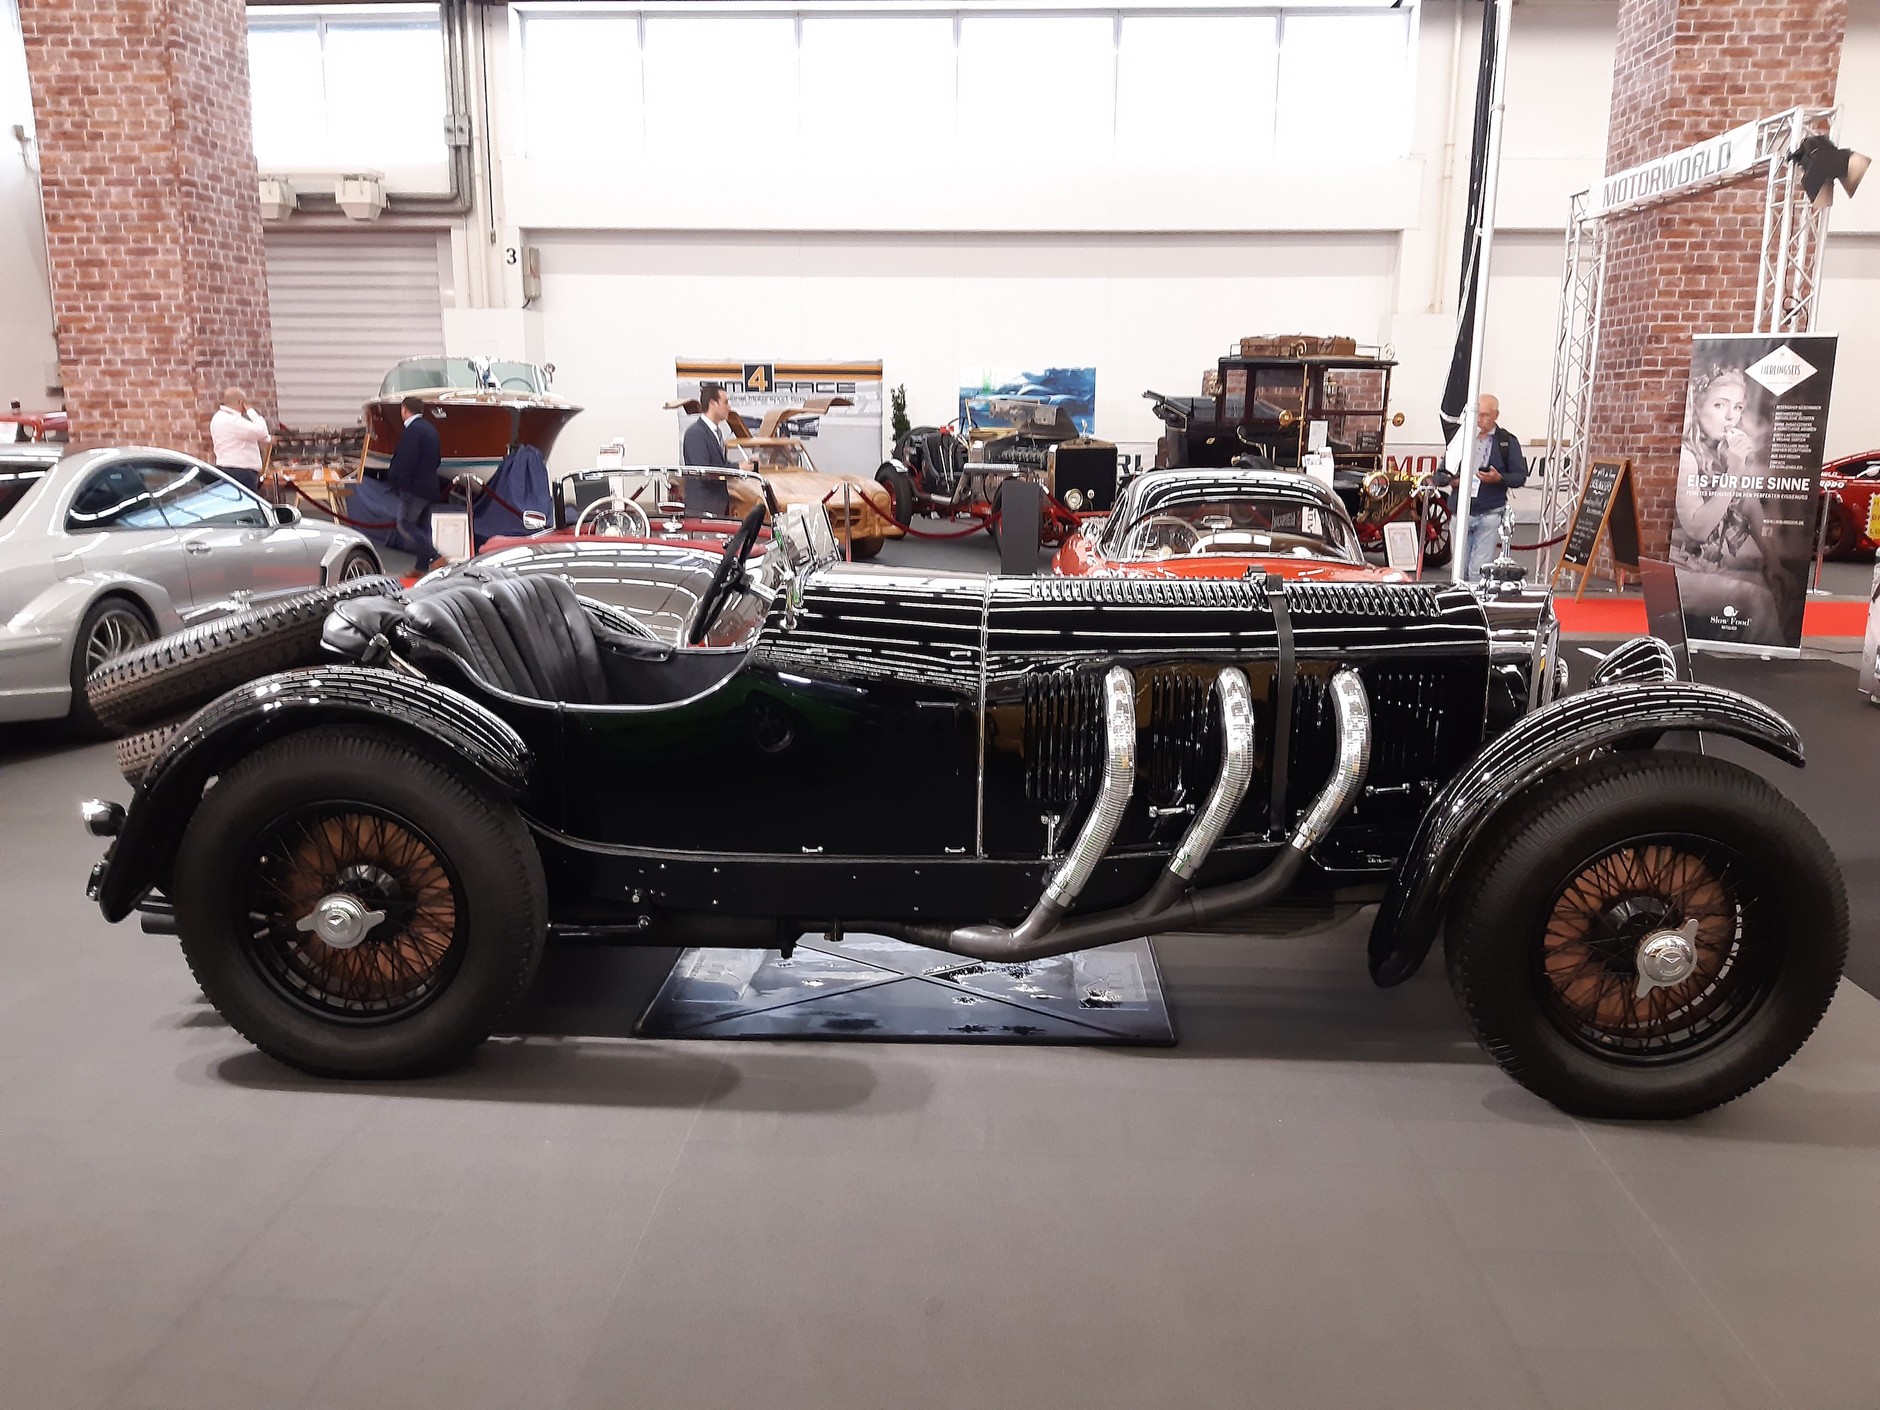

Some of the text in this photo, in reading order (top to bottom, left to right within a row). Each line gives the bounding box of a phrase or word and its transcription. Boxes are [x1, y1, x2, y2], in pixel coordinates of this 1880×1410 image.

[1602, 140, 1732, 208] MOTORWORLD
[506, 247, 517, 265] 3
[747, 365, 768, 393] 4
[775, 381, 856, 394] RACE
[1687, 472, 1811, 491] EIS FÜR DIE SINNE
[1710, 616, 1728, 625] Slow
